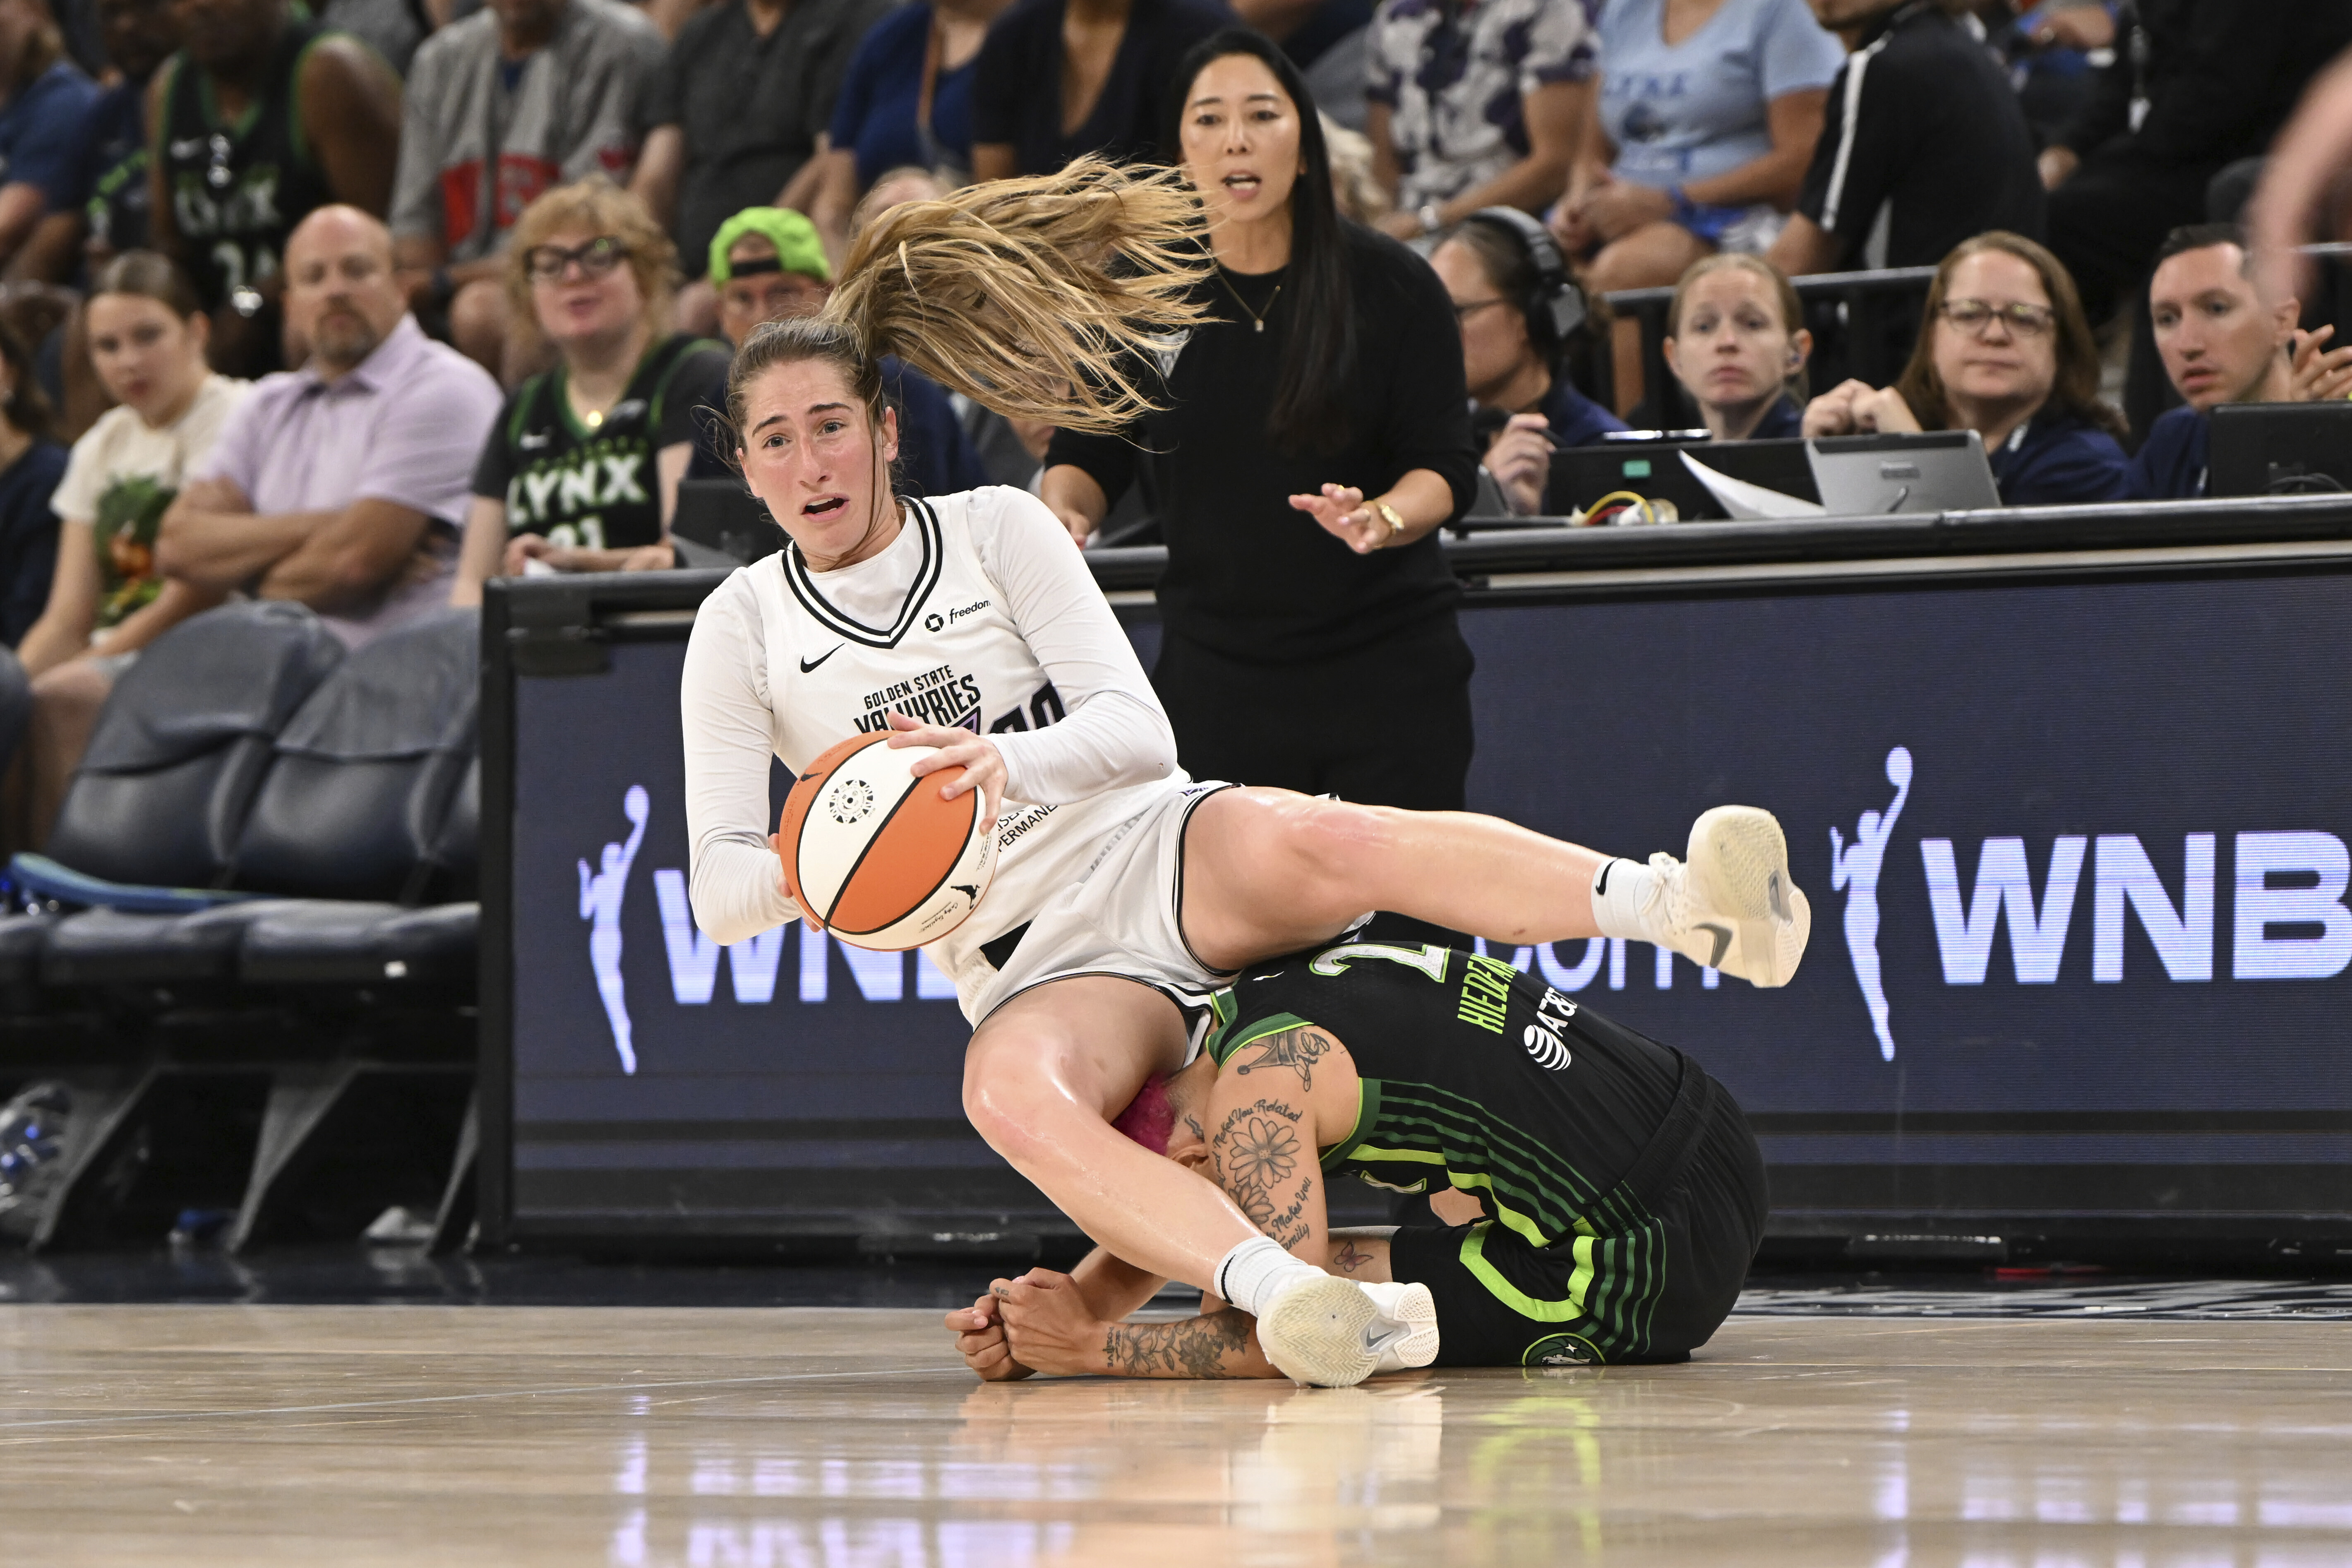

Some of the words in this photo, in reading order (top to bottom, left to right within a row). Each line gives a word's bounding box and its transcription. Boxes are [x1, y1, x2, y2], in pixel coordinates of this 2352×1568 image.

[507, 454, 648, 528] LYNX
[949, 600, 991, 624] freedom
[864, 680, 913, 710] GOLDEN
[914, 664, 954, 691] STATE
[1919, 829, 2352, 986] WNB
[1231, 1107, 1254, 1123] You
[1253, 1098, 1303, 1124] Related
[1271, 1201, 1303, 1233] Makes
[1295, 1176, 1312, 1203] You
